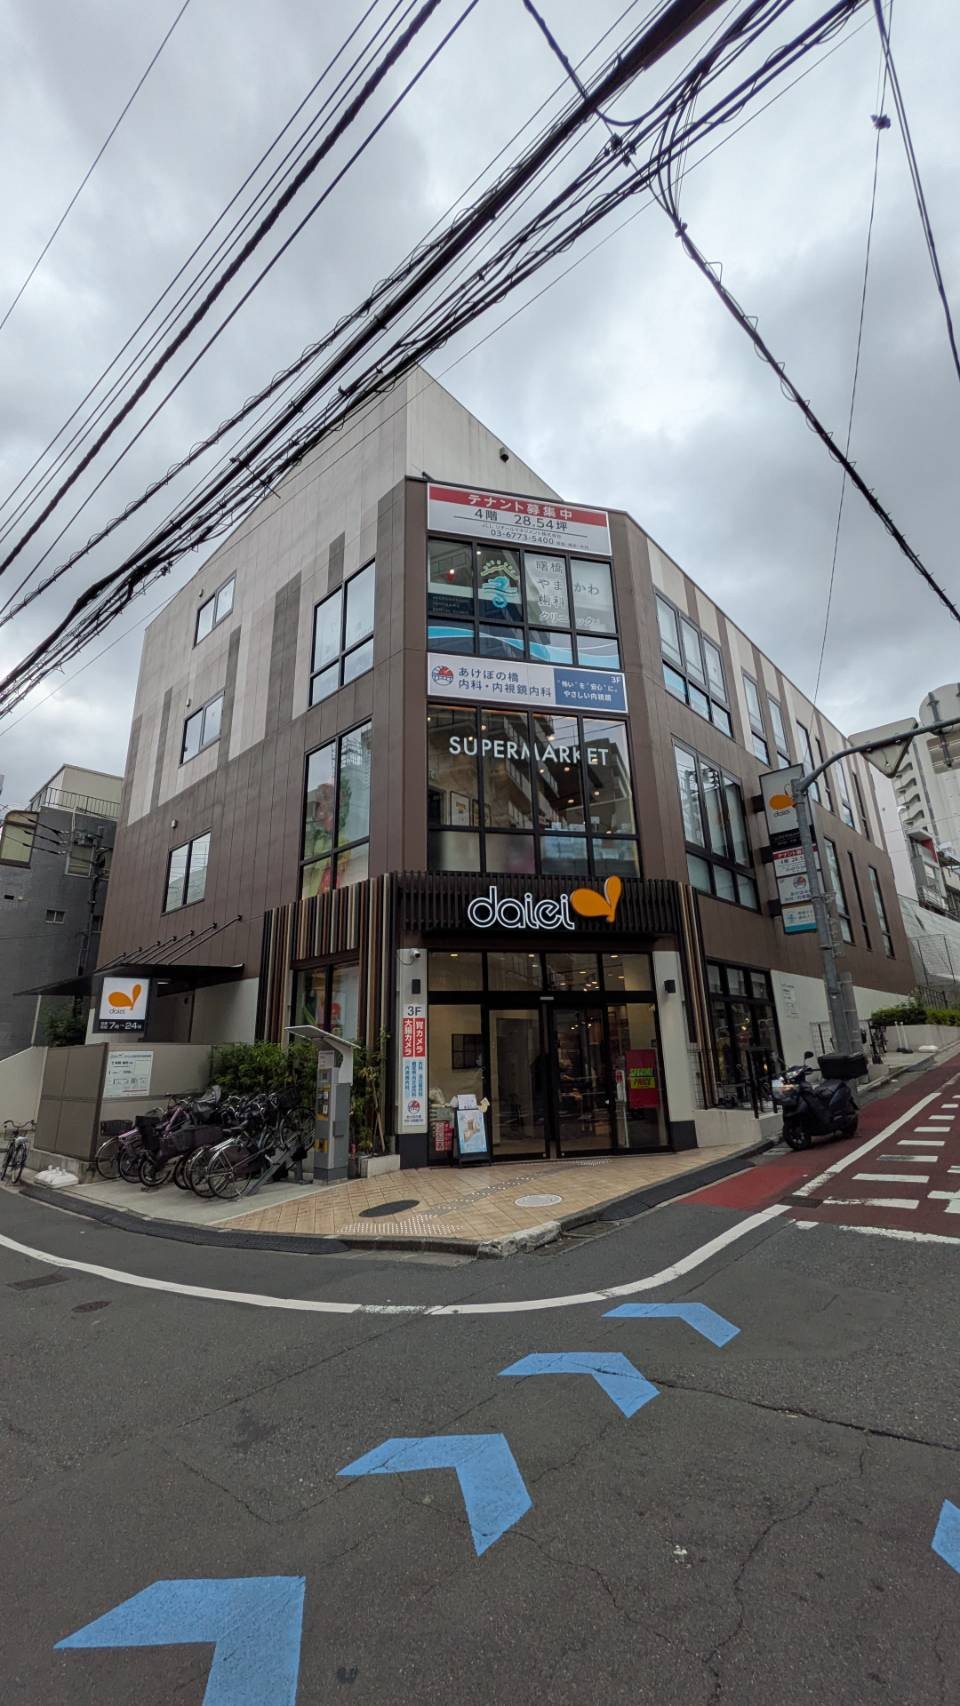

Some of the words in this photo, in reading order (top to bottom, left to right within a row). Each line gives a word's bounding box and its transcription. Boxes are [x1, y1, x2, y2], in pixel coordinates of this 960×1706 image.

[467, 493, 573, 520] テナント募集中
[474, 508, 498, 522] 4階
[514, 514, 568, 532] 28.54坪
[458, 667, 519, 683] あけぼの橋
[458, 679, 552, 698] 内科・内視鏡内科
[467, 886, 575, 930] daiei
[407, 1005, 422, 1017] 3F
